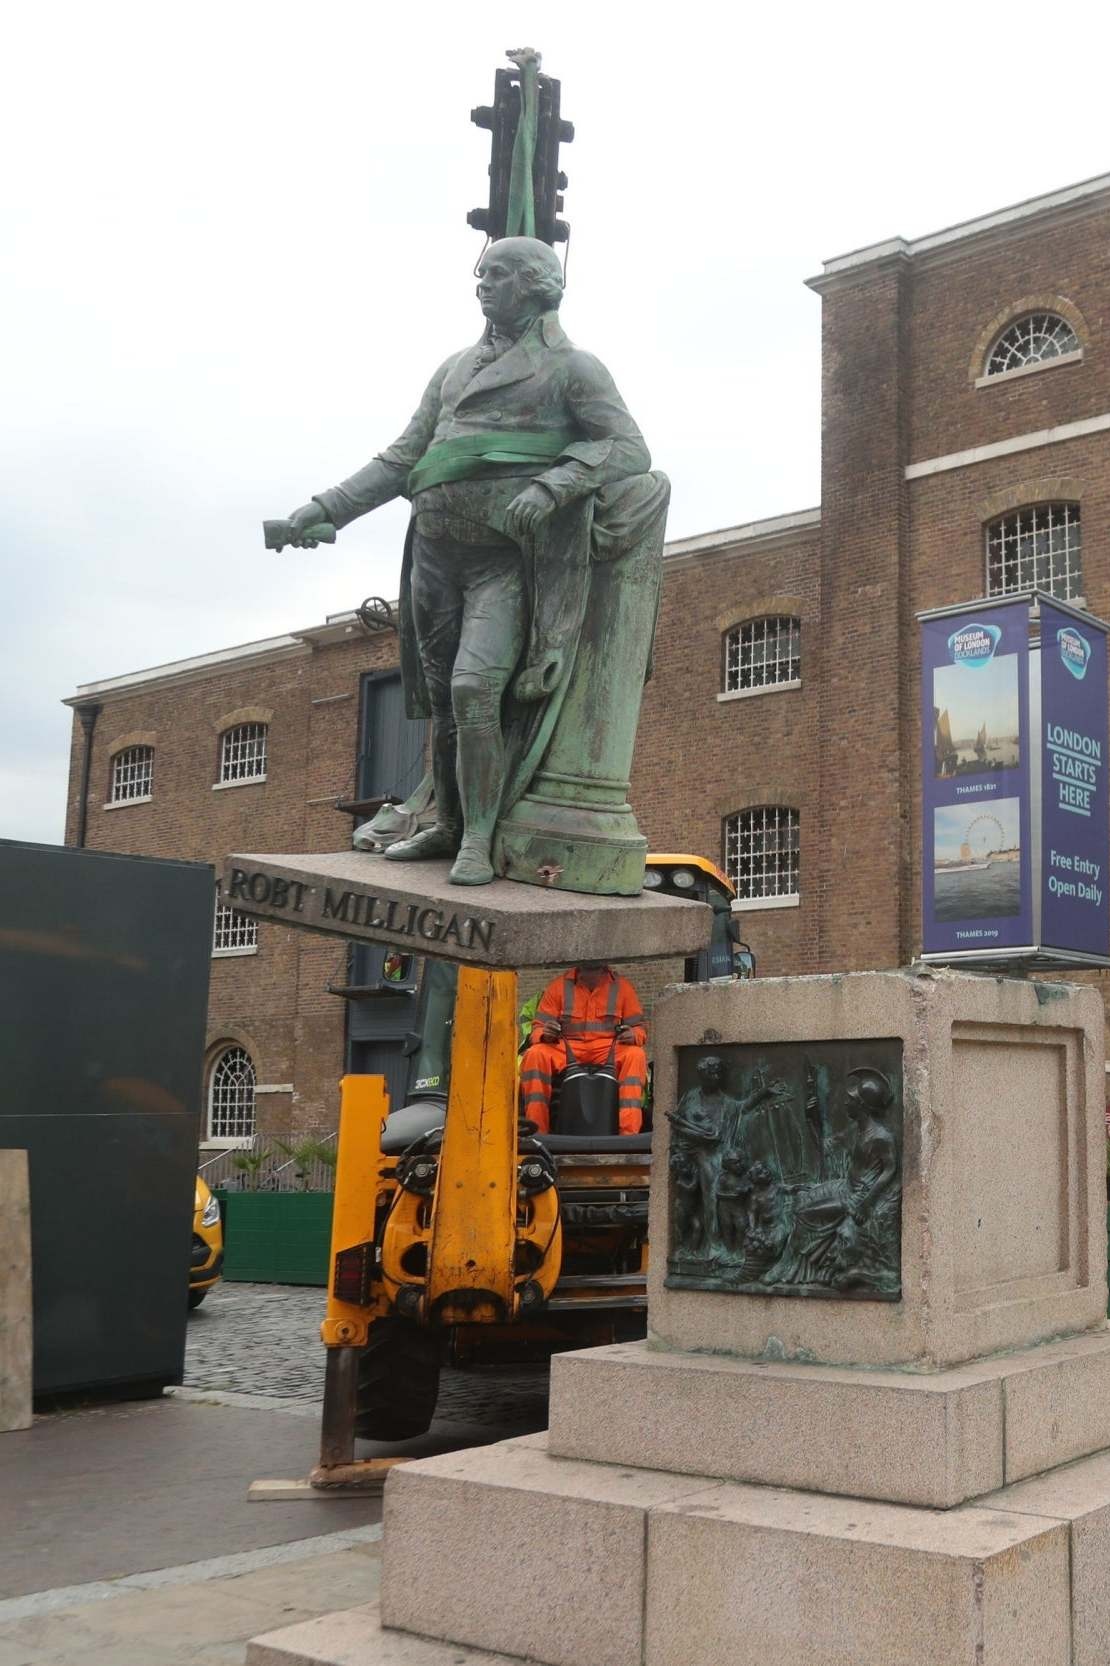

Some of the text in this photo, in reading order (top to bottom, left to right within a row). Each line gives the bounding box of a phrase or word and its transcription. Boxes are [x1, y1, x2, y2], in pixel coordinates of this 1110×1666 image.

[954, 631, 984, 643] MUSEUM
[954, 638, 990, 651] OF LONDON
[1047, 722, 1101, 758] LONDON
[1053, 753, 1096, 783] STARTS
[956, 784, 983, 795] THAMES
[1060, 783, 1090, 809] HERE
[1050, 850, 1100, 881] Free Entry
[1048, 875, 1103, 906] Open Daily
[230, 868, 496, 953] ROBT MILLIGAN
[956, 930, 983, 940] THAMES
